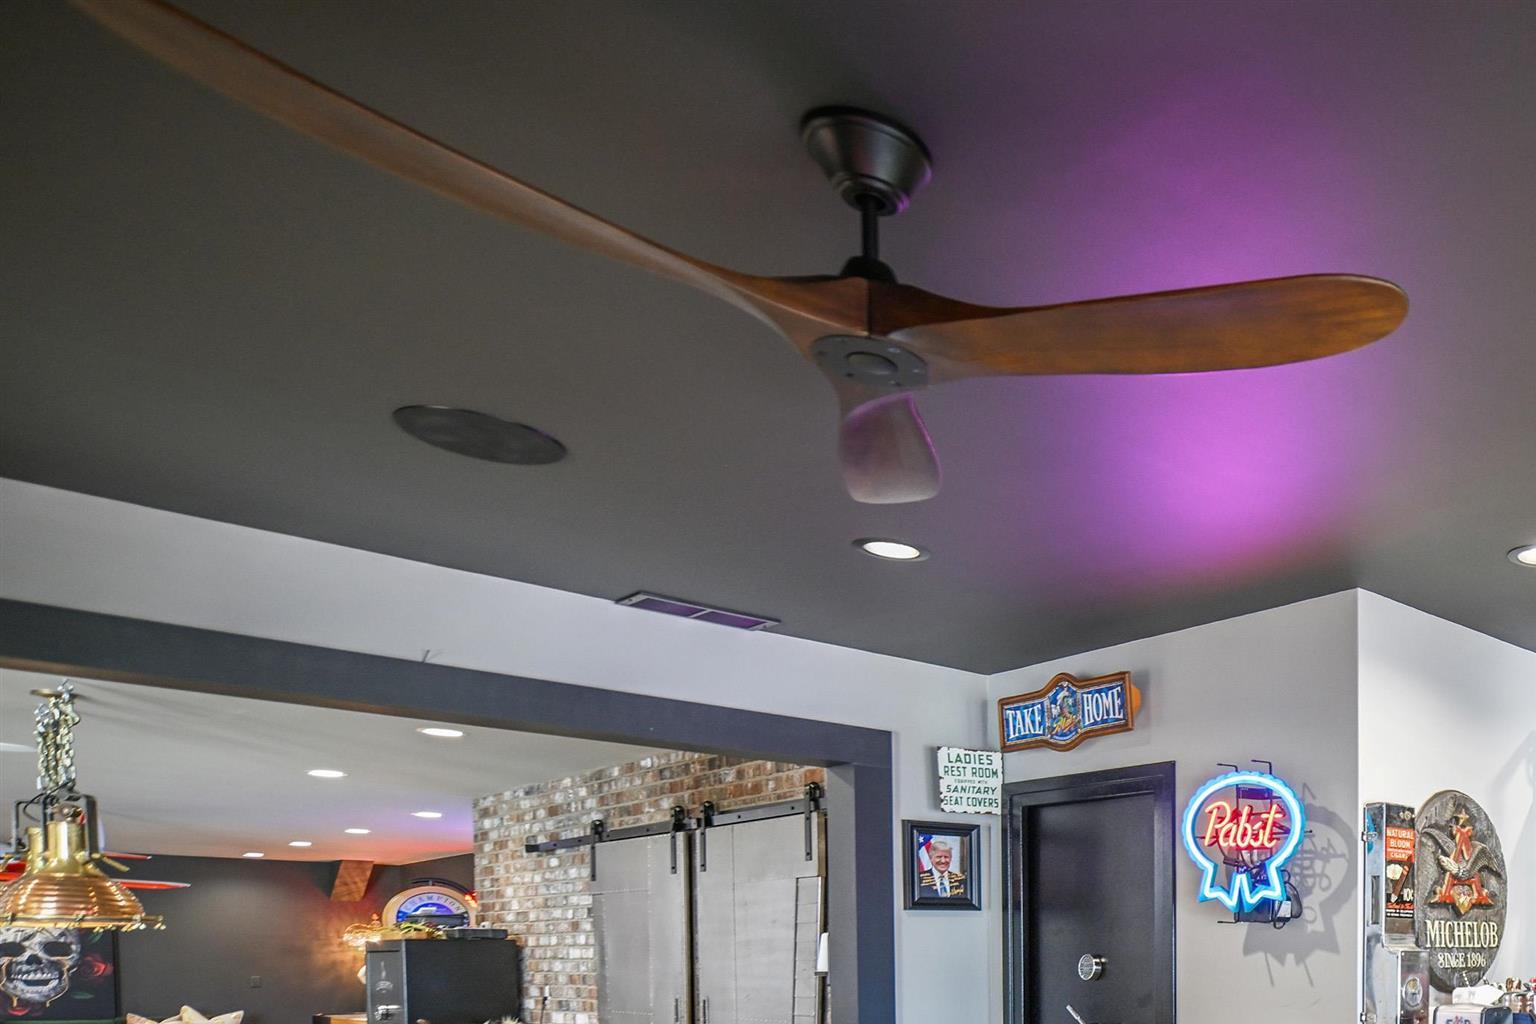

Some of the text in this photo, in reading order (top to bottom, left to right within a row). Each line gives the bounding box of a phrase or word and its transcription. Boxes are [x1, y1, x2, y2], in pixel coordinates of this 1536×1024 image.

[1006, 705, 1043, 739] TAKE
[1083, 687, 1123, 725] HOME
[948, 752, 993, 765] LADIES
[944, 766, 998, 778] REST ROOM
[946, 784, 998, 795] SANITARY
[943, 796, 999, 808] SEAT COVERS
[1205, 801, 1283, 847] Pabst
[1387, 829, 1414, 839] NATURAL
[1390, 840, 1410, 849] BLOOM
[1425, 920, 1498, 948] MICHELOB
[1438, 952, 1486, 968] SINCE 1896
